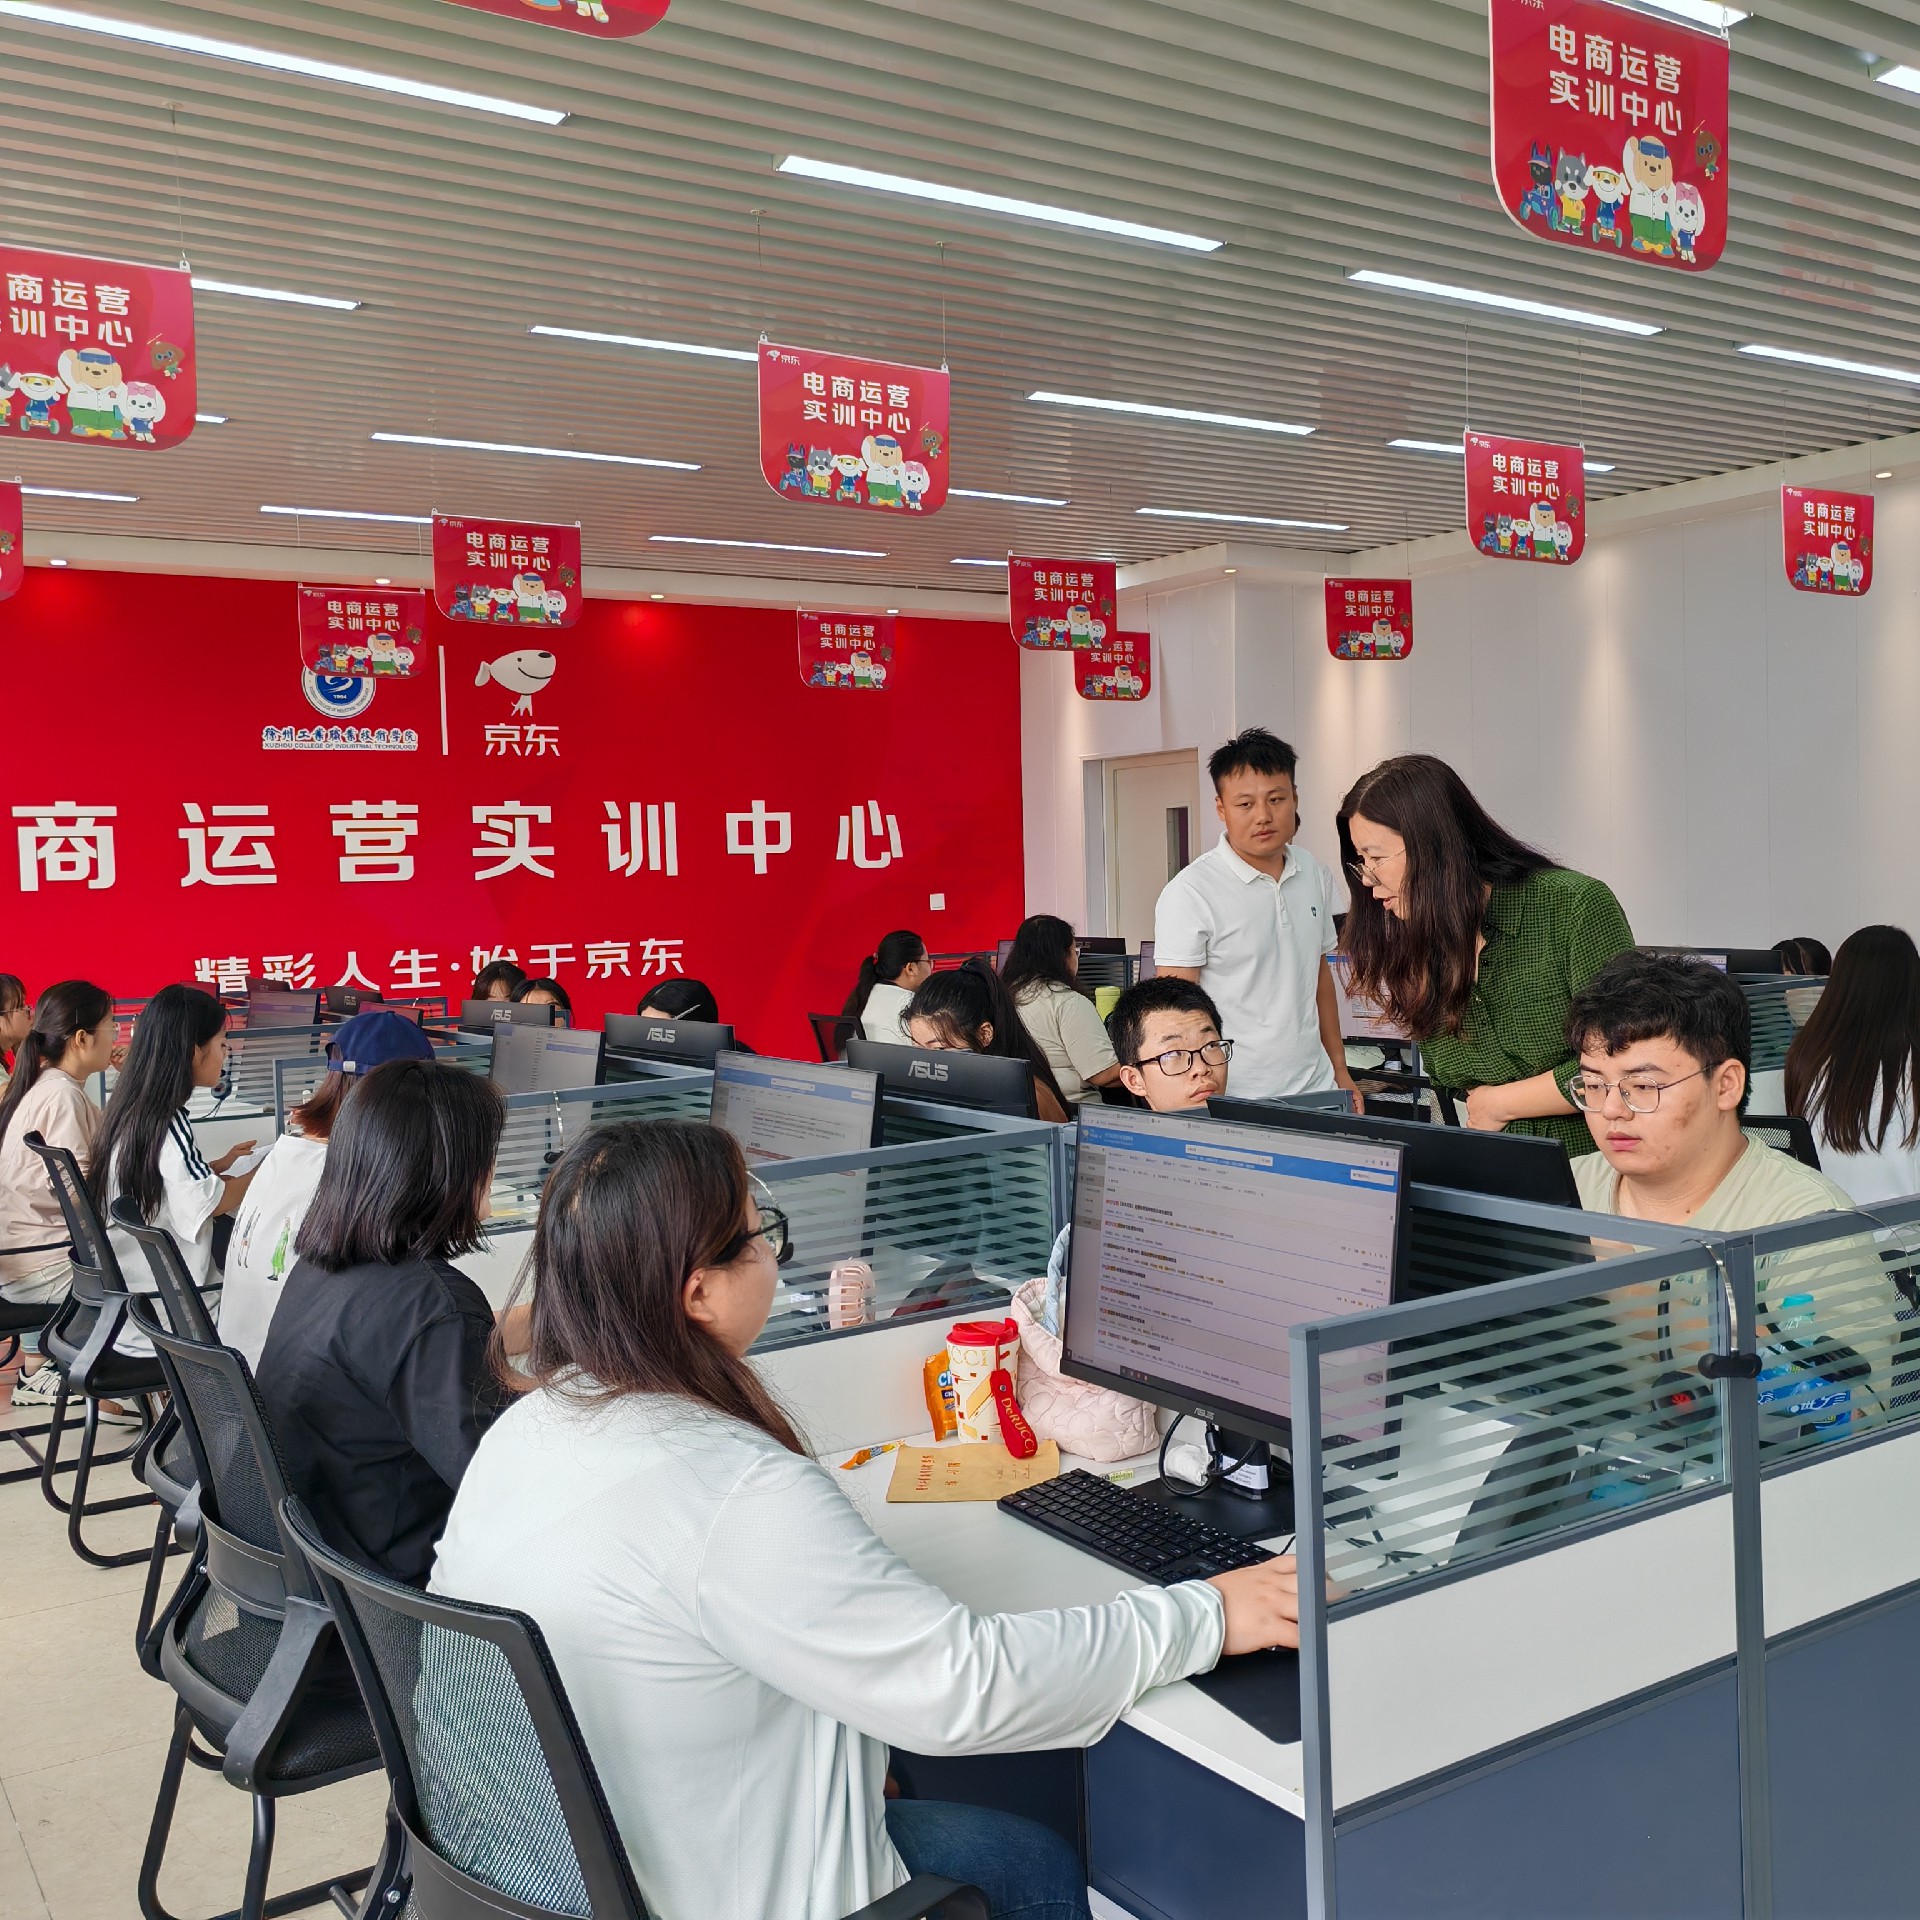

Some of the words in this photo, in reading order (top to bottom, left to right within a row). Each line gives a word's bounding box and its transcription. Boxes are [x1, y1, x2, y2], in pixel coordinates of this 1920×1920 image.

[1550, 24, 1682, 94] 电商运营
[1550, 71, 1682, 136] 实训中心
[6, 273, 131, 316] 商运营
[0, 307, 134, 347] 训中心
[781, 354, 800, 365] 京东
[803, 371, 910, 408] 电商运营
[803, 400, 911, 434] 实训中心
[1492, 453, 1559, 479] 电商运营
[1492, 475, 1560, 500] 实训中心
[1803, 501, 1856, 523] 电商运营
[1803, 520, 1856, 541] 实训中心
[466, 531, 550, 554] 电商运营
[467, 551, 551, 572] 实训中心
[1033, 570, 1094, 588] 电商运营
[1034, 587, 1095, 603] 实训中心
[1344, 590, 1395, 603] 电商运营
[327, 600, 399, 617] 电商运营
[1345, 605, 1395, 617] 实训中心
[328, 616, 400, 632] 实训中心
[820, 622, 875, 637] 电商运营
[820, 637, 876, 651] 实训中心
[1108, 641, 1134, 652] 运营
[1090, 652, 1134, 664] 实训中心
[484, 722, 560, 757] 京东
[12, 799, 903, 892] 商运营实训中心
[490, 1009, 512, 1021] ASUS
[646, 1027, 676, 1044] ASUS
[908, 1060, 949, 1082] ASUS
[1194, 1407, 1215, 1421] ASUS
[1001, 1397, 1035, 1454] DeRUCCI
